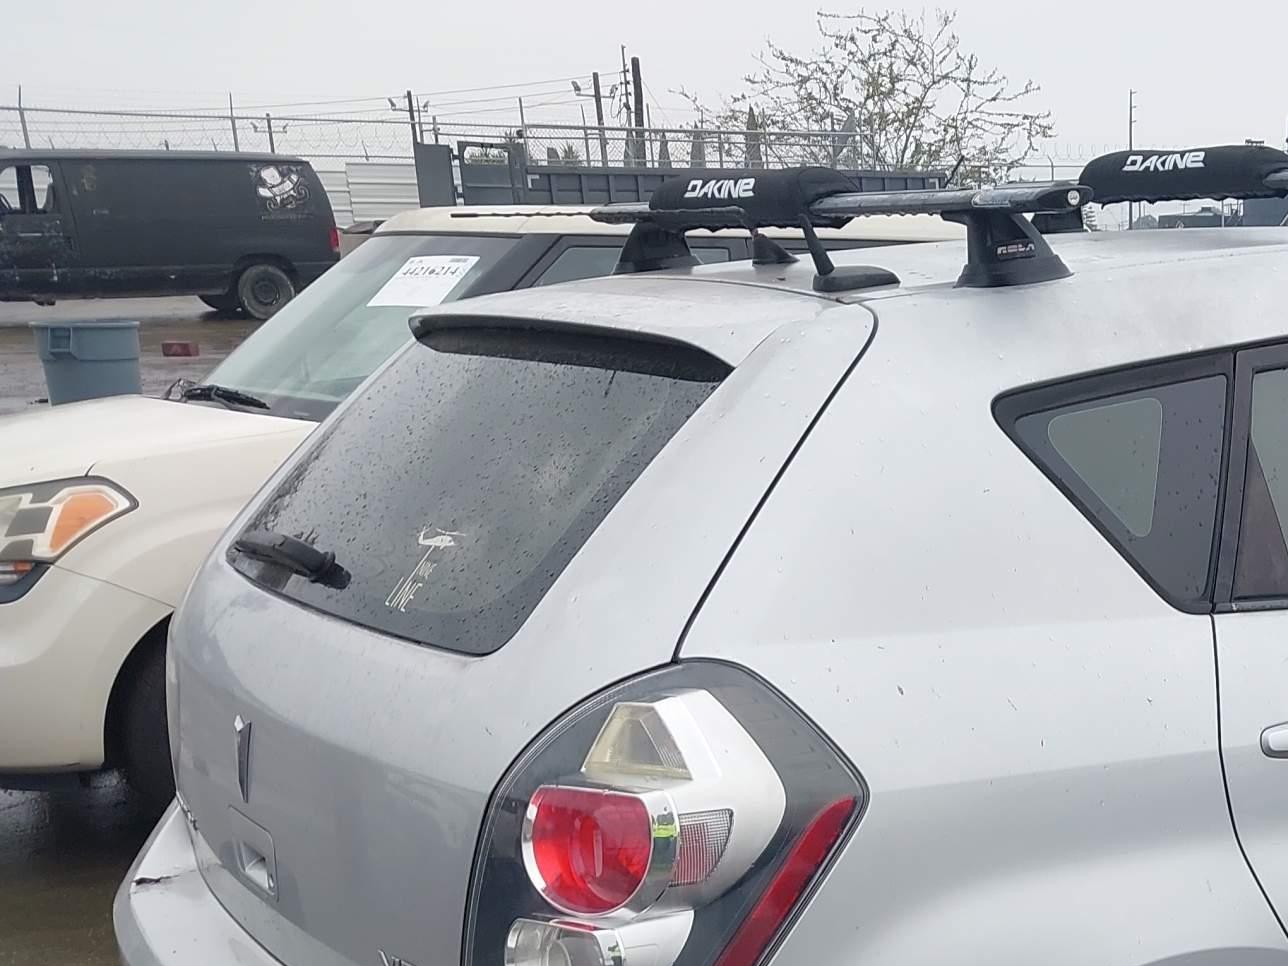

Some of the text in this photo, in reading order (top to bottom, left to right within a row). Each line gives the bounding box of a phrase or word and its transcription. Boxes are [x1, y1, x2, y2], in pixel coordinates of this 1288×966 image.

[1121, 151, 1206, 172] DAKINE
[683, 177, 756, 199] DAKINE
[385, 576, 423, 612] LINE
